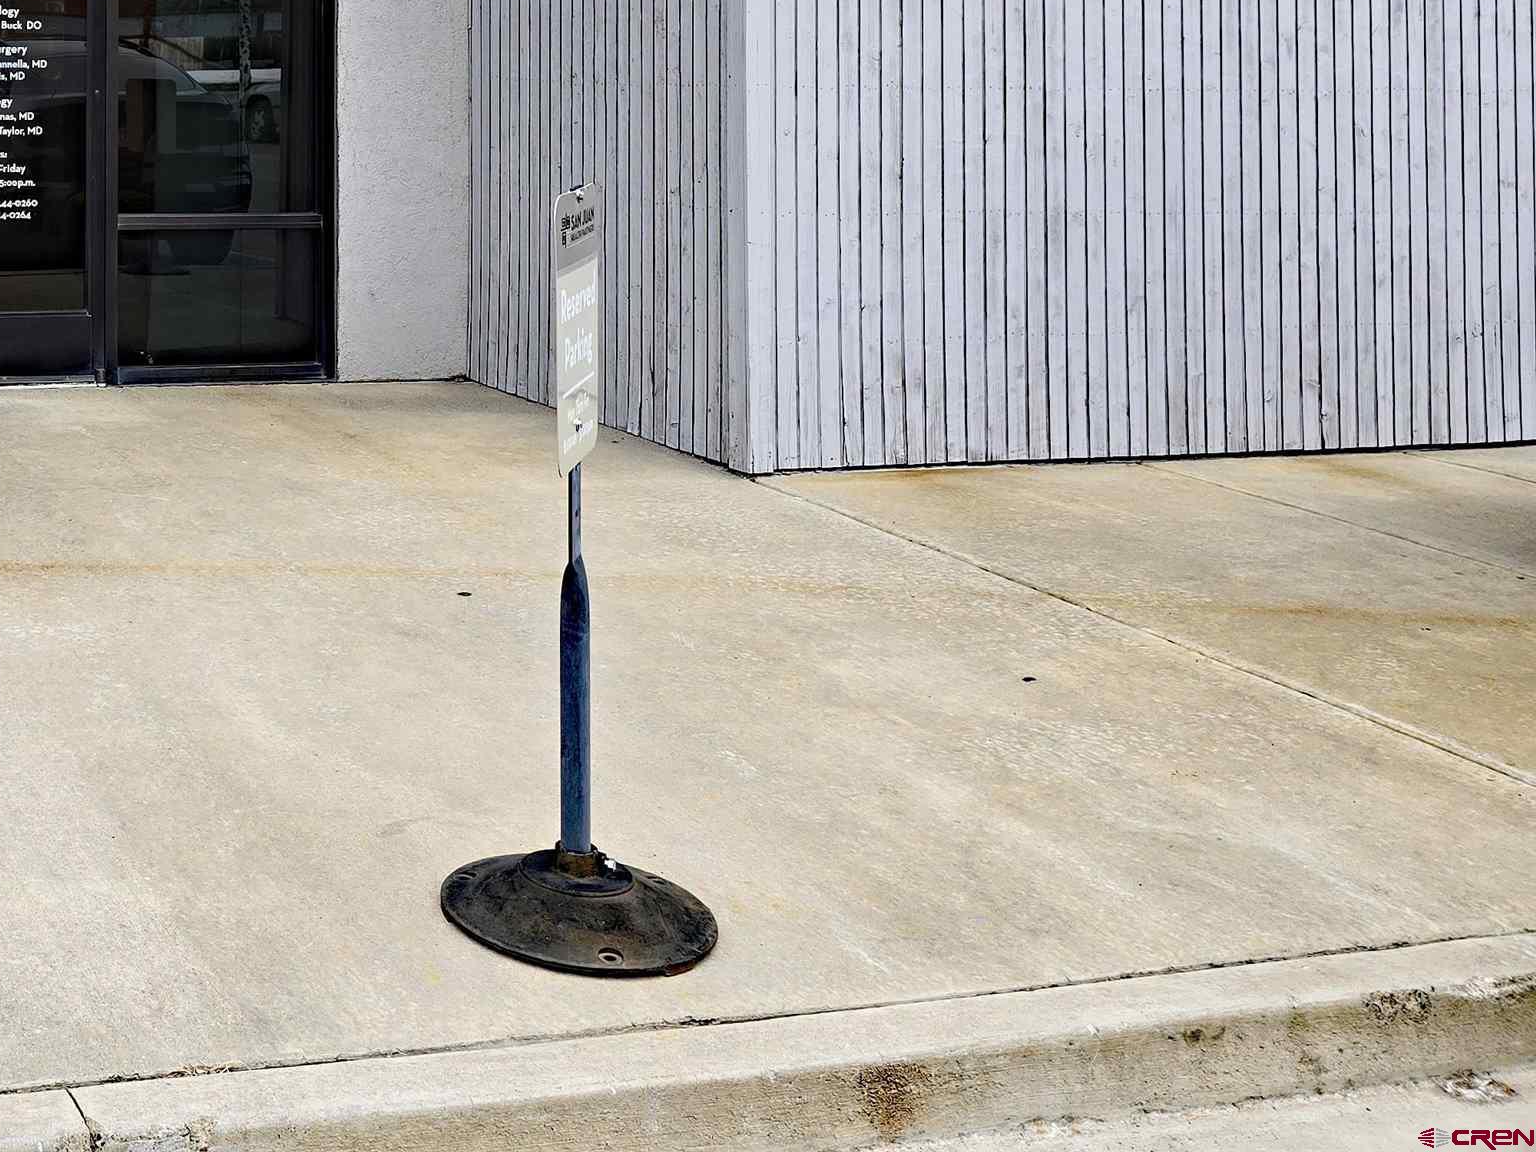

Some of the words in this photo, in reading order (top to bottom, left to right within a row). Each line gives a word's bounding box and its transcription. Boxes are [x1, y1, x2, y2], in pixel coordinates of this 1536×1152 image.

[1, 20, 23, 30] Buck
[26, 20, 42, 30] DO
[31, 60, 47, 68] MD
[9, 71, 25, 80] MD
[18, 112, 35, 120] MD
[27, 126, 43, 135] MD
[560, 283, 597, 324] Reserved
[564, 328, 593, 372] Parking
